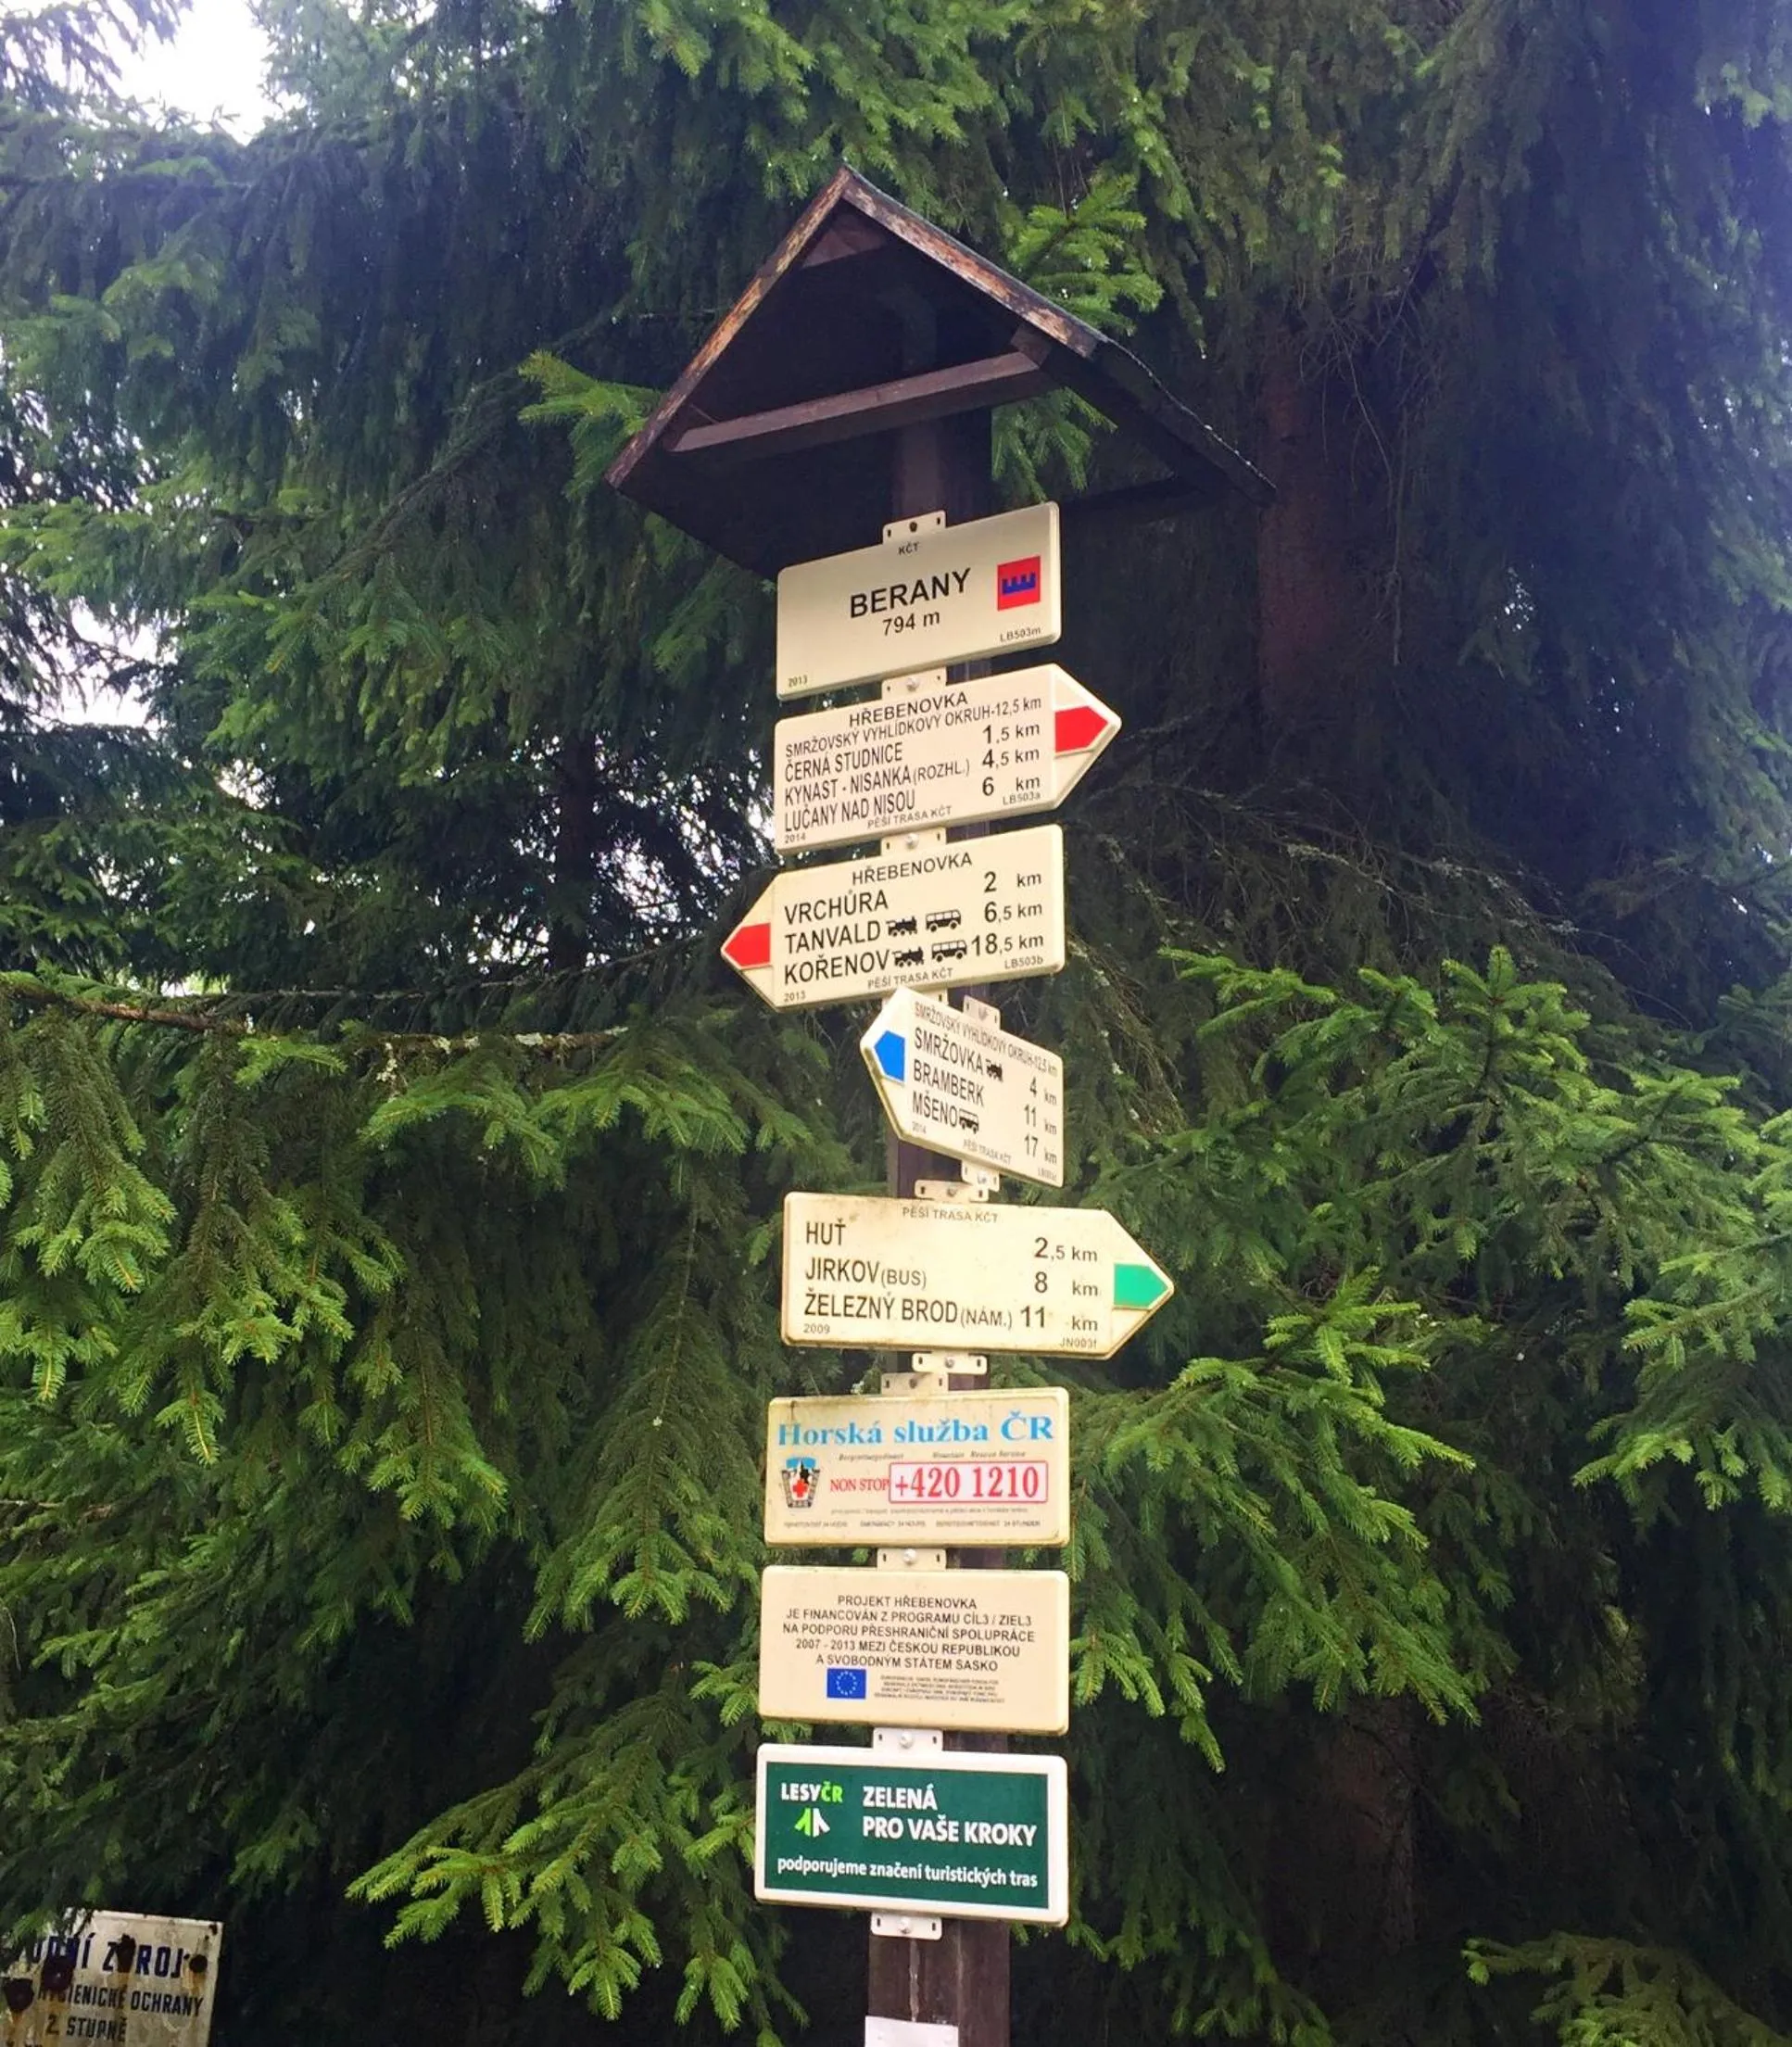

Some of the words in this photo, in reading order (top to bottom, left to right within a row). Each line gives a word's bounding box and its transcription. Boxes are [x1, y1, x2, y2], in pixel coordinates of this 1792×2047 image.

[898, 541, 921, 556] KČT
[850, 567, 971, 619] BERANY
[882, 613, 915, 637] 794
[923, 610, 940, 627] m
[849, 691, 968, 727] HŘEBENOVKA
[1022, 696, 1041, 711] km
[785, 754, 831, 782] ČERNÁ
[835, 741, 903, 773] STUDNICE
[982, 725, 1010, 745] 1,5
[1015, 724, 1041, 739] km
[784, 778, 839, 806] KYNAST
[982, 749, 1010, 770] 4,5
[1015, 749, 1040, 764] km
[784, 801, 839, 832] LUČANY
[841, 798, 869, 823] NAD
[877, 789, 915, 815] NISOU
[982, 777, 994, 796] 6
[1016, 776, 1041, 791] km
[892, 809, 928, 826] TRASA
[852, 852, 972, 887] HŘEBENOVKA
[984, 871, 996, 893] 2
[1016, 872, 1041, 888] km
[785, 920, 881, 954] TANVALD
[984, 902, 1012, 924] 6,5
[1017, 903, 1042, 919] km
[784, 949, 890, 985] KOŘENOV
[971, 932, 1013, 957] 18,5
[1018, 934, 1043, 949] km
[893, 971, 929, 986] TRASA
[915, 1027, 984, 1076] SMRŽOVKA
[1029, 1076, 1037, 1098] 4
[1044, 1088, 1057, 1106] km
[914, 1059, 984, 1106] BRAMBERK
[1024, 1104, 1037, 1128] 11
[1044, 1118, 1057, 1135] km
[913, 1090, 958, 1128] MŠENO
[1024, 1134, 1038, 1157] 17
[1044, 1149, 1057, 1164] km
[932, 1207, 972, 1221] TRASA
[806, 1218, 846, 1246] HUŤ
[1034, 1237, 1065, 1260] 2,5
[1072, 1245, 1098, 1262] km
[1035, 1271, 1048, 1294] 8
[1072, 1280, 1099, 1296] km
[804, 1287, 895, 1320] ŽELEZNÝ
[1020, 1306, 1046, 1329] 11
[1072, 1315, 1098, 1332] km
[803, 1323, 830, 1335] 2009
[778, 1421, 882, 1447] Horská
[894, 1418, 989, 1443] služba
[1001, 1410, 1054, 1442] ČR
[830, 1478, 857, 1492] NON
[859, 1478, 889, 1492] STOP
[895, 1466, 961, 1498] +420
[973, 1466, 1040, 1498] 1210
[787, 1609, 801, 1619] JE
[803, 1609, 877, 1622] FINANCOVÁN
[880, 1611, 888, 1622] Z
[891, 1611, 960, 1624] PROGRAMU
[964, 1612, 989, 1625] CÍL3
[999, 1614, 1031, 1626] ZIEL3
[838, 1595, 891, 1608] PROJEKT
[894, 1596, 977, 1610] HŘEBENOVKA
[783, 1624, 799, 1634] NA
[802, 1624, 858, 1636] PODPORU
[862, 1624, 949, 1639] PŘESHRANIČNÍ
[952, 1628, 1035, 1642] SPOLUPRÁCE
[796, 1638, 820, 1649] 2007
[830, 1640, 855, 1651] 2013
[859, 1641, 886, 1652] MEZI
[890, 1640, 939, 1654] ČESKOU
[942, 1644, 1020, 1657] REPUBLIKOU
[816, 1654, 824, 1664] A
[827, 1654, 901, 1668] SVOBODNÝM
[905, 1656, 953, 1669] STÁTEM
[956, 1660, 998, 1672] SASKO
[863, 1783, 938, 1810] ZELENÁ
[863, 1815, 903, 1839] PRO
[908, 1813, 959, 1843] VAŠE
[965, 1822, 1037, 1847] KROKY
[777, 1855, 866, 1876] podporujeme
[870, 1861, 922, 1879] značení
[925, 1864, 1006, 1889] turistických
[1010, 1870, 1038, 1887] tras
[131, 1990, 205, 2016] OCHRANY
